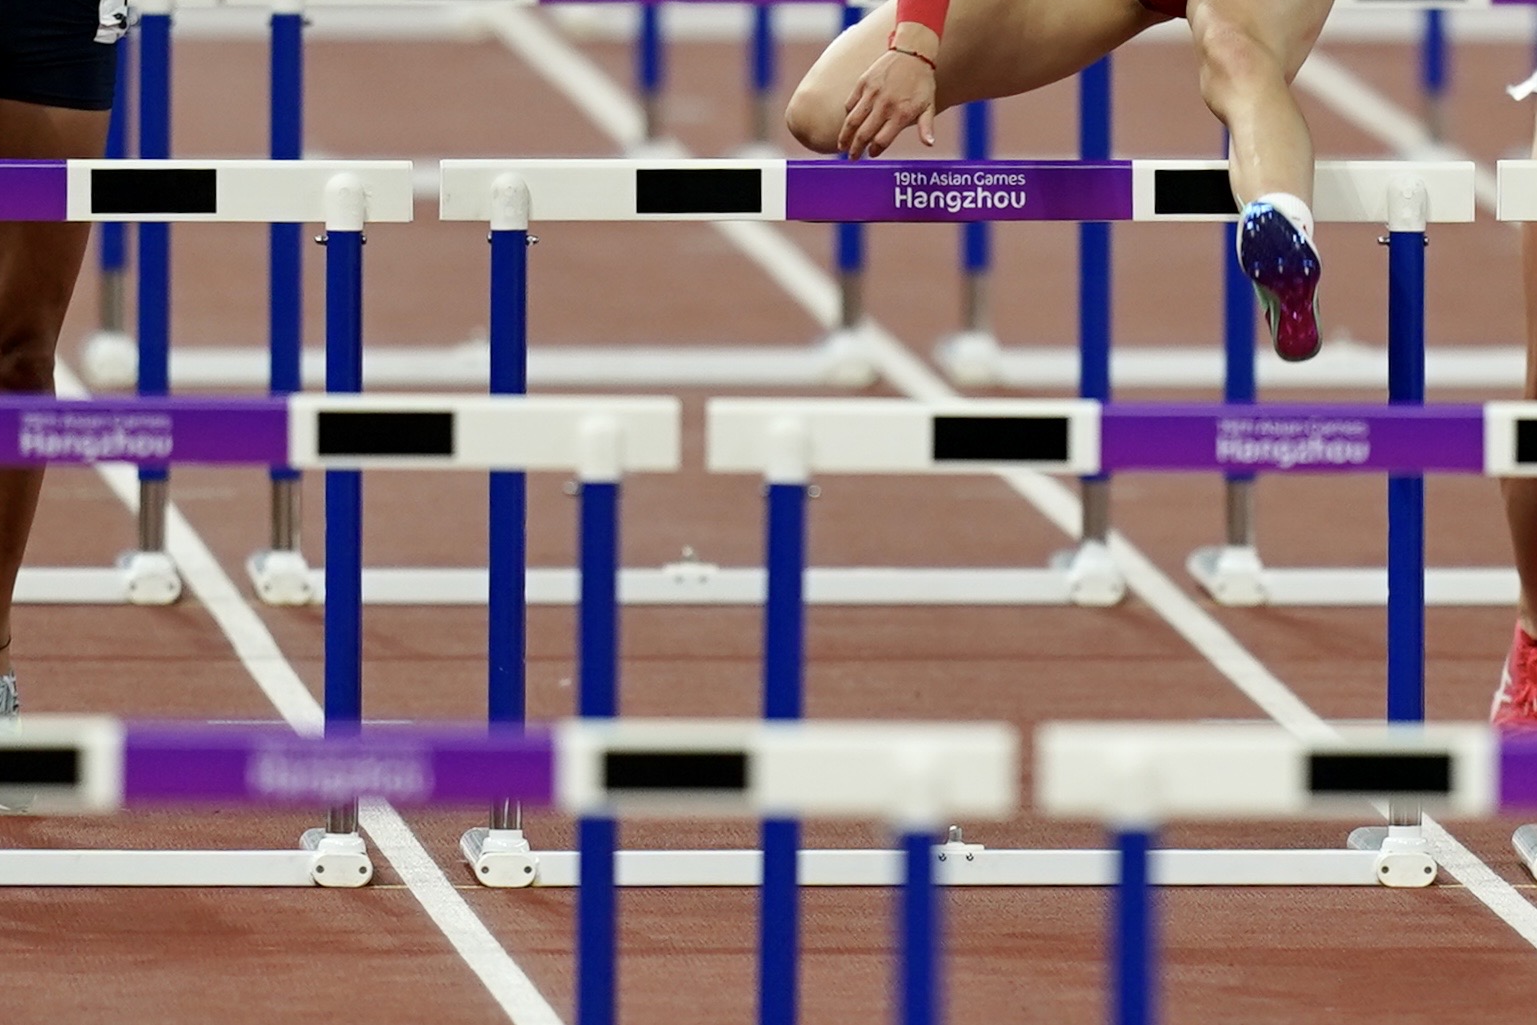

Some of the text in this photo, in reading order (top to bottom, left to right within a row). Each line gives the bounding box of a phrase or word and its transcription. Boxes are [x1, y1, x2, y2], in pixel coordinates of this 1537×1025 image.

[894, 171, 1026, 186] 19th Asian Games
[895, 186, 1026, 213] Hangzhou
